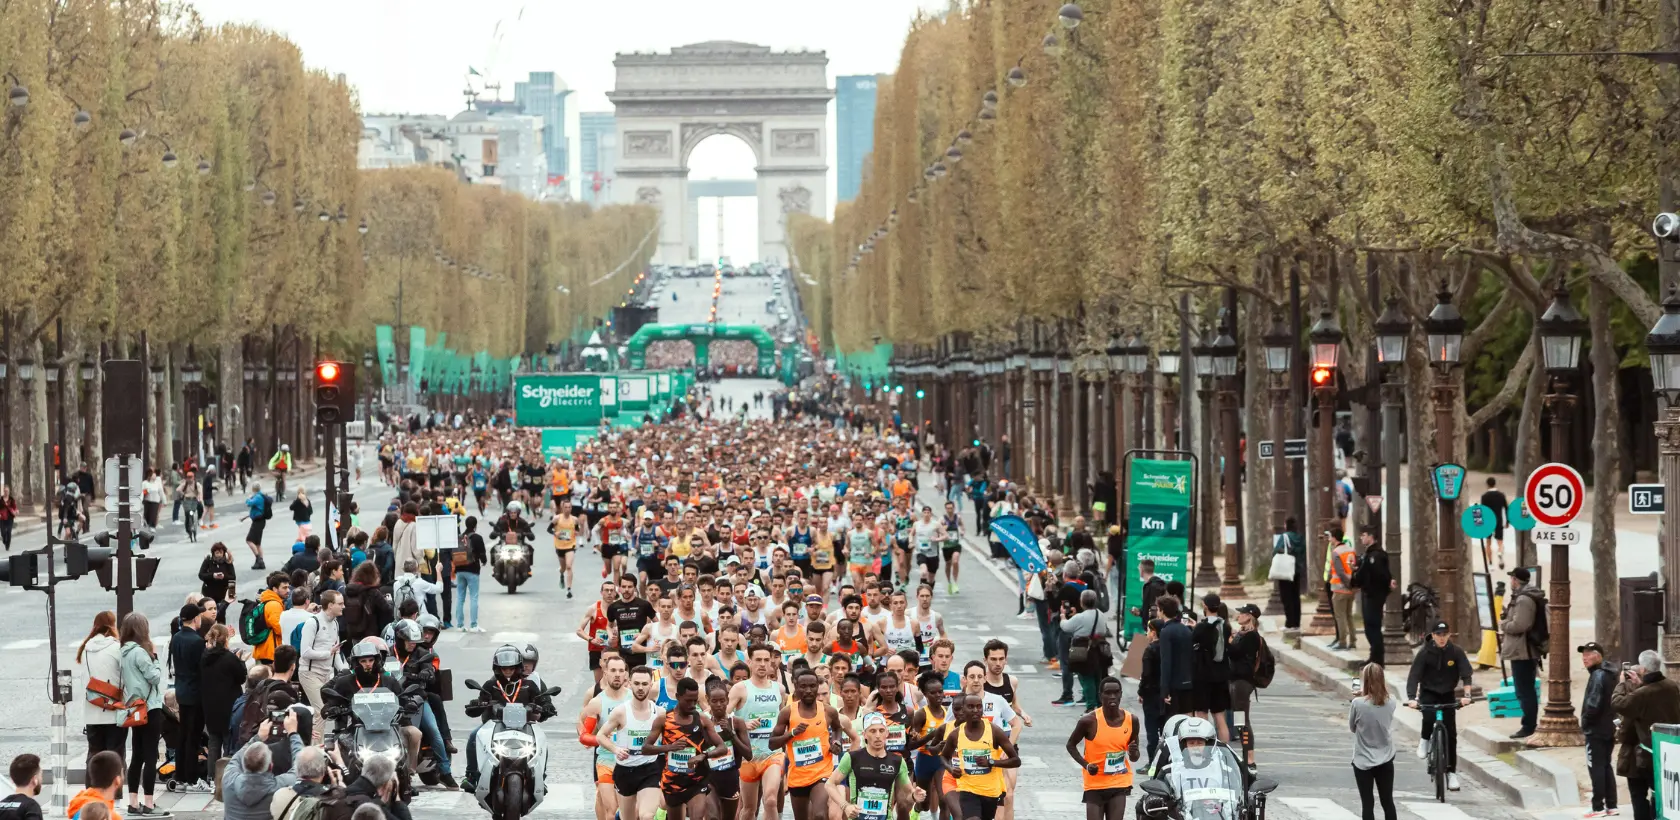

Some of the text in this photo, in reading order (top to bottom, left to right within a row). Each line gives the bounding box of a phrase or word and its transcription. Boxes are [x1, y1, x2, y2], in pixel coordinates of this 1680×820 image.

[522, 385, 595, 399] Schneider
[552, 398, 593, 406] Electric
[1538, 484, 1573, 509] 50
[1141, 516, 1165, 529] Km
[1536, 531, 1575, 540] AXE 50
[1137, 552, 1179, 563] Schneider
[760, 719, 770, 728] 52
[1186, 778, 1209, 790] TV
[868, 800, 879, 809] 114
